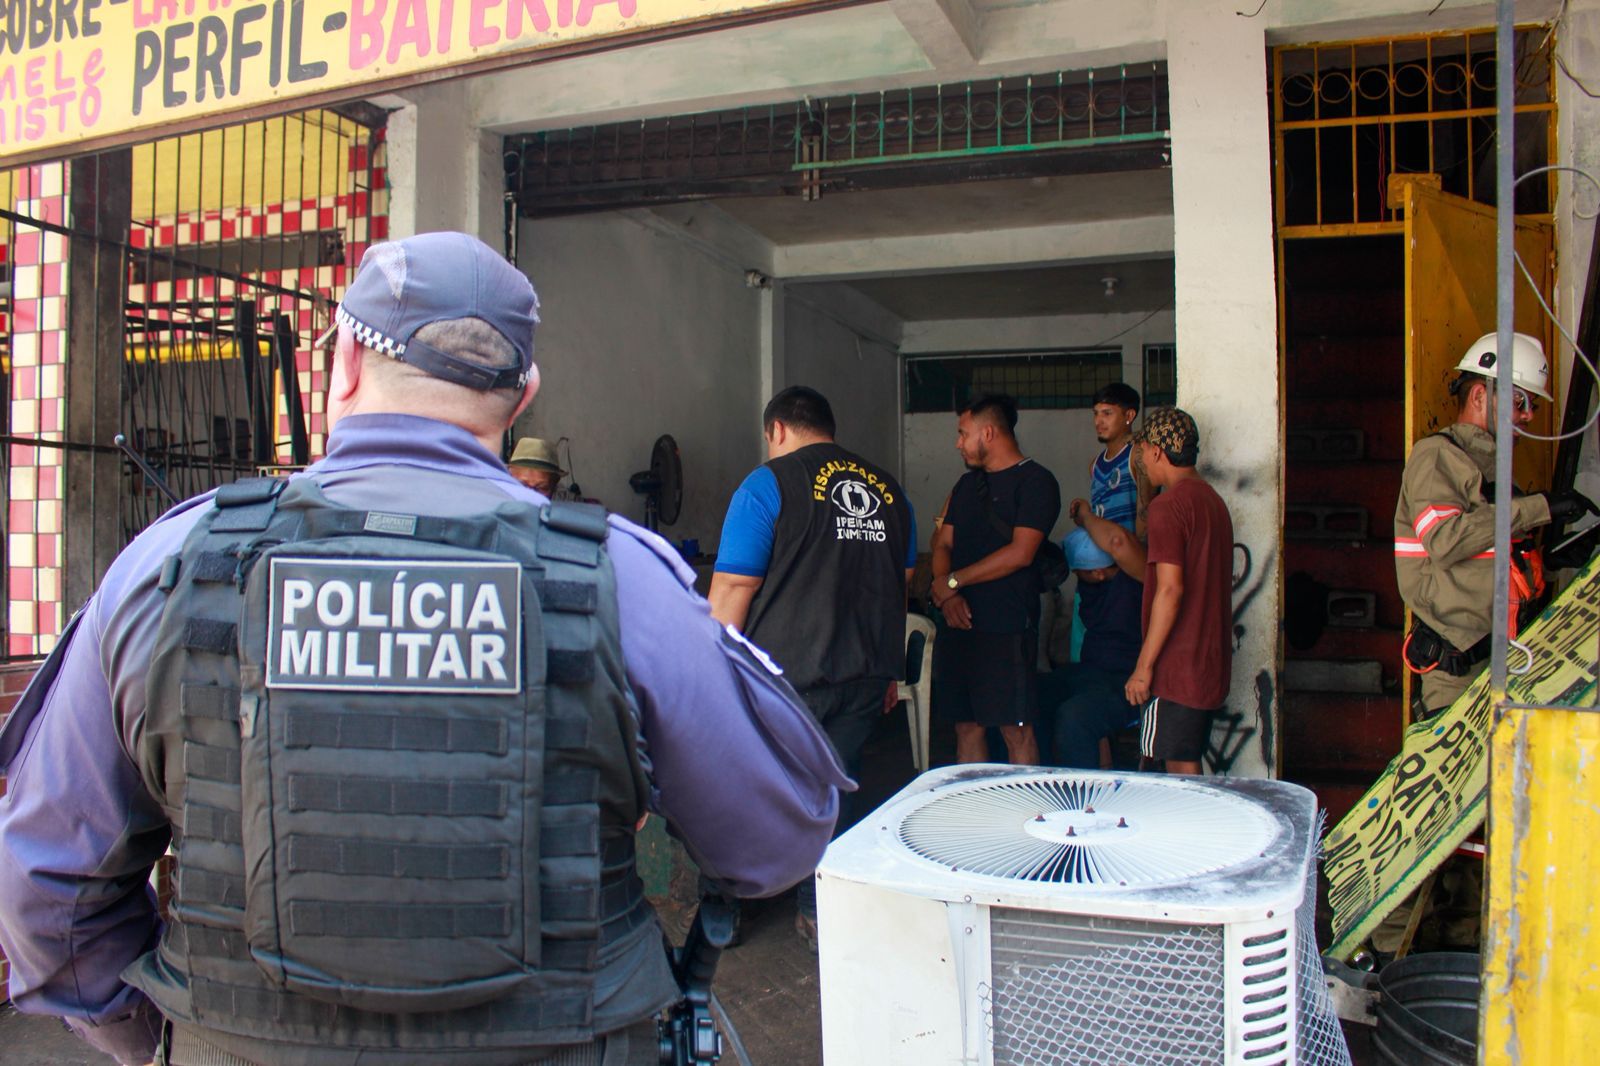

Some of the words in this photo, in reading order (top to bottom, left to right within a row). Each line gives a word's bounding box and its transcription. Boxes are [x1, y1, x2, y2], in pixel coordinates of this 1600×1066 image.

[0, 86, 102, 144] ISTO
[836, 528, 887, 542] INMETRO
[282, 571, 508, 631] POLÍCIA
[279, 630, 508, 681] MILITAR
